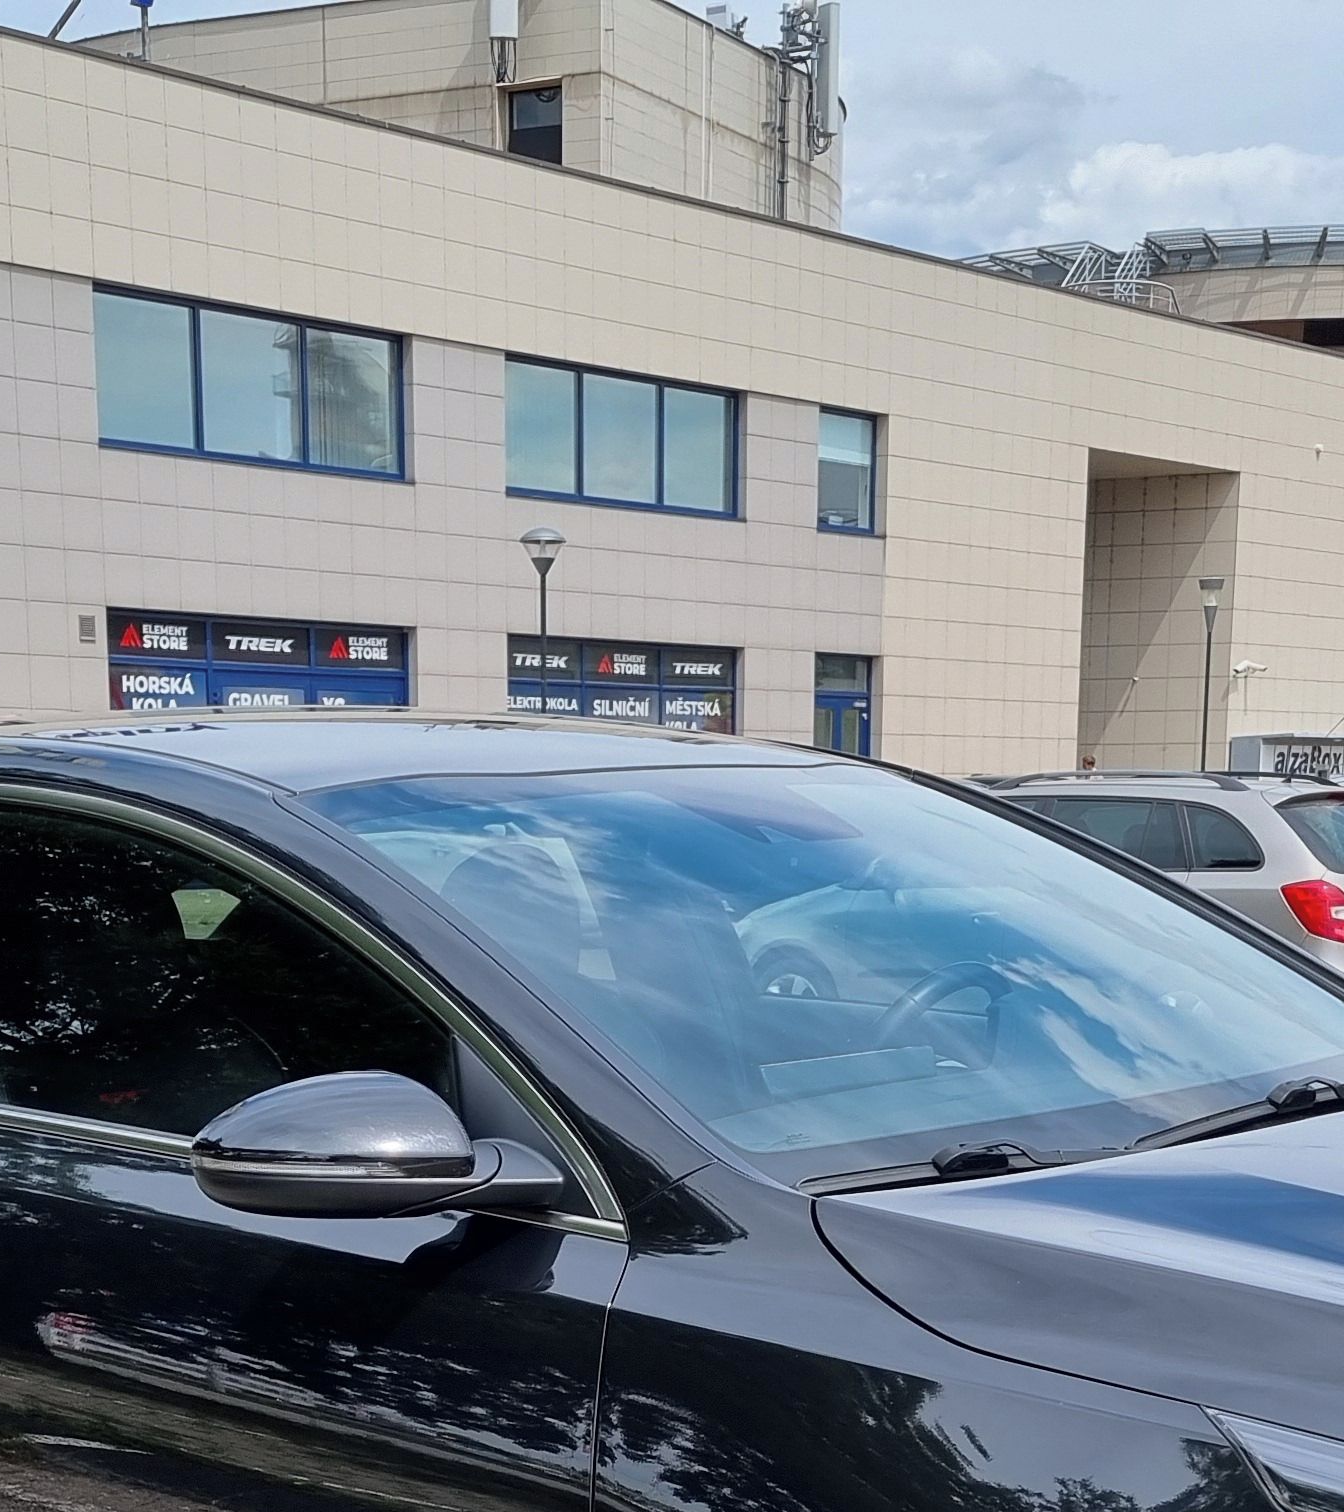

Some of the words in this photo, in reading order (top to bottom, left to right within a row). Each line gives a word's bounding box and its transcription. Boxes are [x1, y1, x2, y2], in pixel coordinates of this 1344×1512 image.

[142, 623, 189, 637] ELEMENT
[142, 635, 189, 651] STORE
[224, 635, 296, 653] TREK
[348, 636, 389, 648] ELEMENT
[348, 646, 389, 660] STORE
[613, 654, 647, 664] ELEMENT
[512, 653, 569, 669] TREK
[613, 663, 647, 676] STORE
[672, 662, 723, 676] TREK
[122, 673, 196, 695] HORSKÁ
[132, 697, 177, 710] KOLA
[592, 697, 651, 717] SILNIČNÍ
[665, 697, 721, 717] MĚSTSKÁ
[1274, 745, 1342, 775] alzaBox
